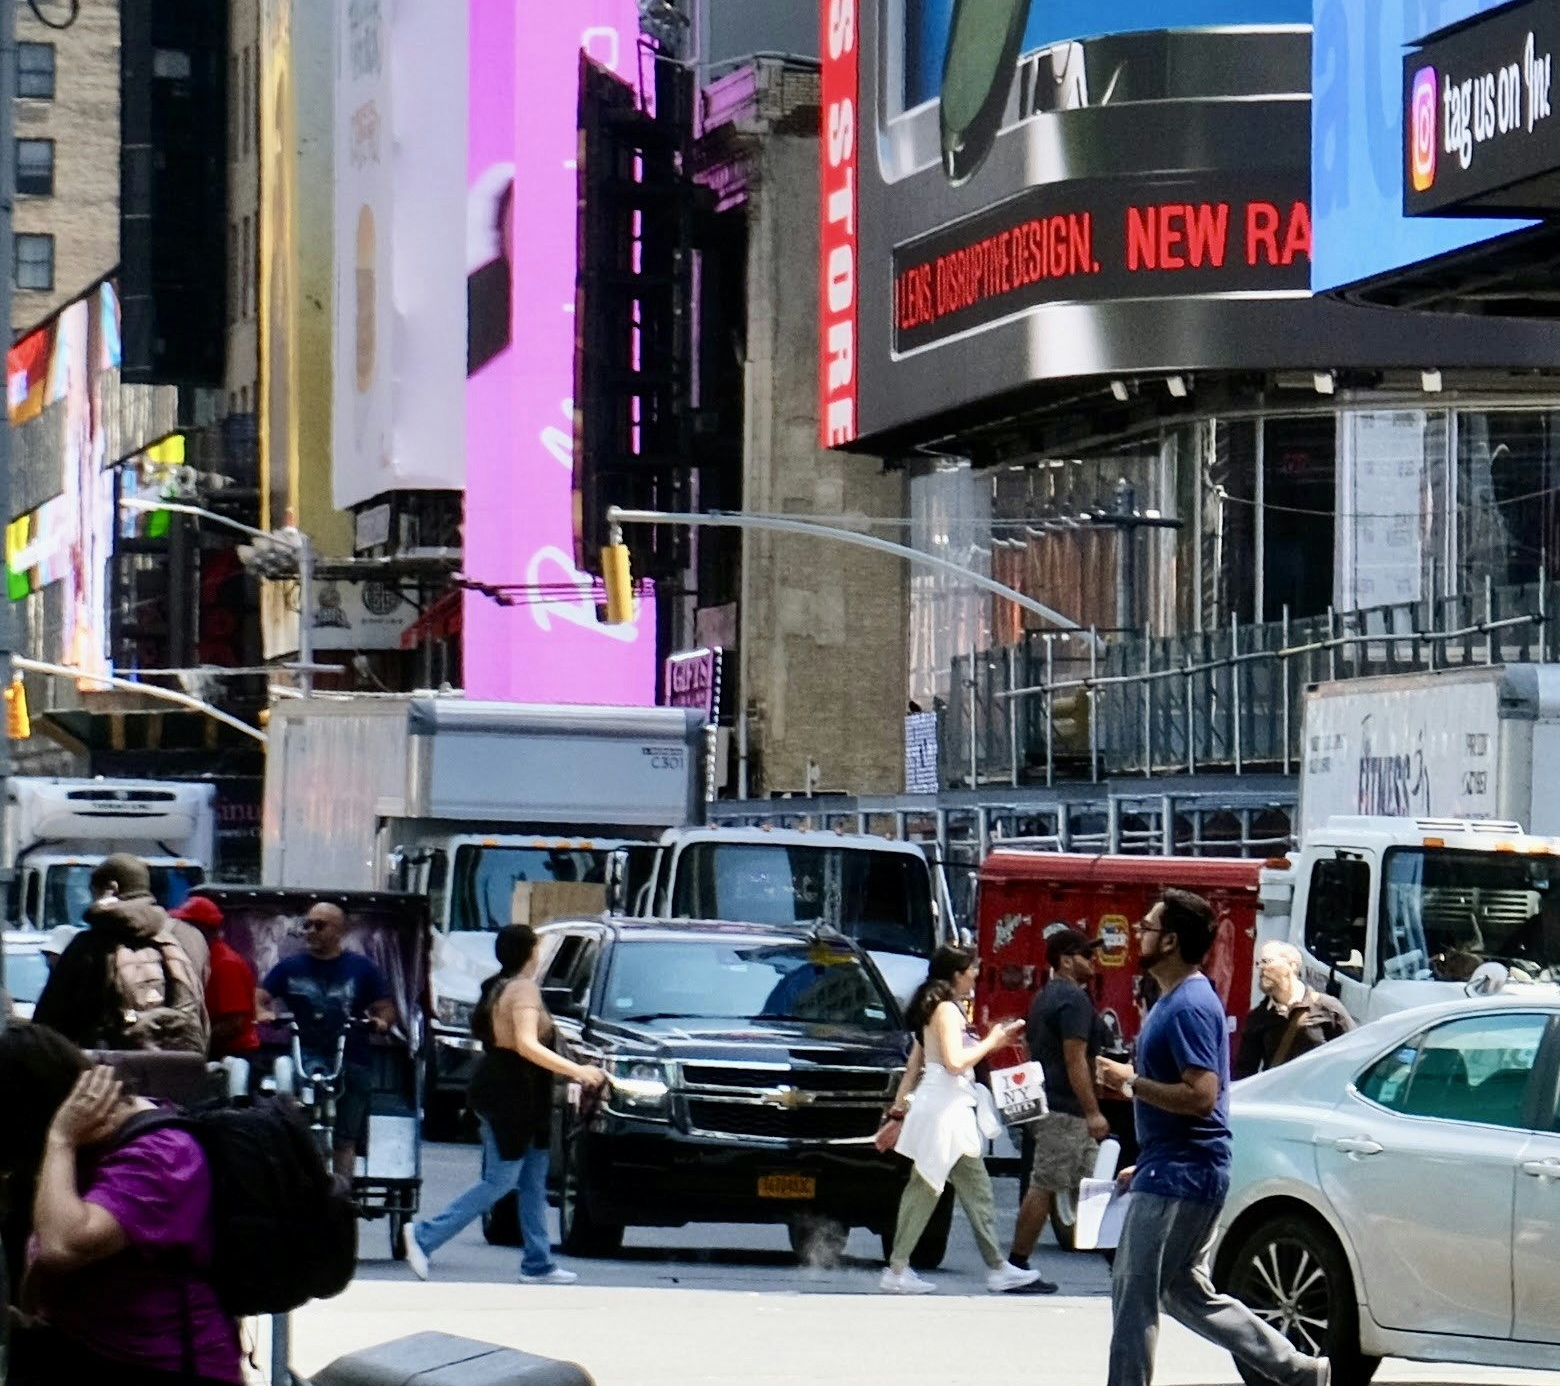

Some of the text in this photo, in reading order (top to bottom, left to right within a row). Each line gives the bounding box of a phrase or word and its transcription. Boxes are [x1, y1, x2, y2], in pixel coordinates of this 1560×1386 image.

[1443, 74, 1473, 170] tag
[1473, 72, 1495, 142] us
[1498, 63, 1521, 134] on
[826, 116, 858, 446] STORE
[1012, 211, 1101, 293] DESIGN.
[1128, 203, 1228, 270] NEW
[1003, 1087, 1029, 1105] NY
